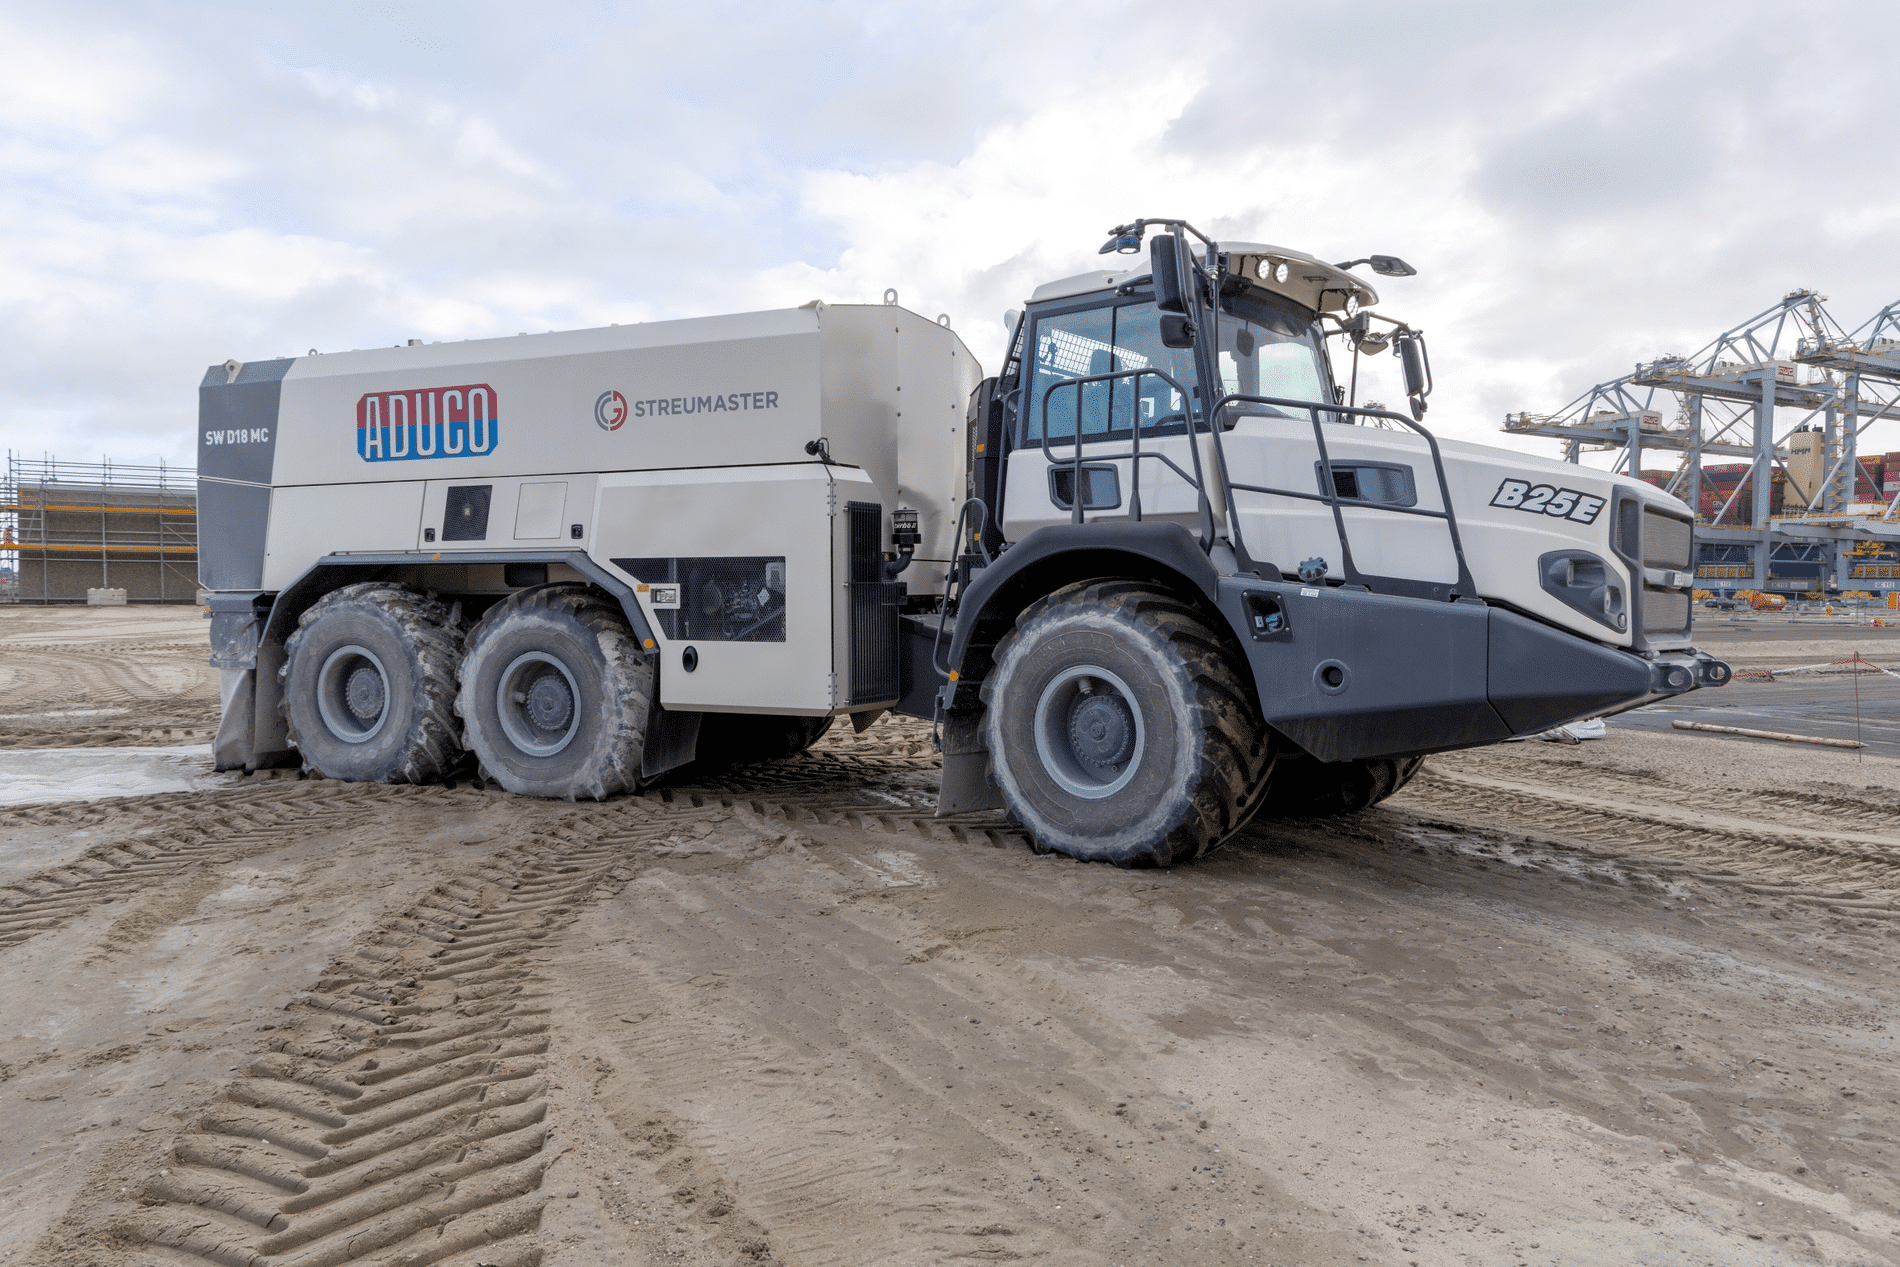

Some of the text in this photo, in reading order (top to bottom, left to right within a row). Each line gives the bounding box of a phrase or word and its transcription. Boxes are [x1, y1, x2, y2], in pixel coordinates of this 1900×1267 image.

[365, 386, 490, 460] ADUCO
[635, 391, 779, 418] STREUMASTER
[205, 427, 269, 445] SW D18 MC
[1488, 477, 1608, 525] B25E
